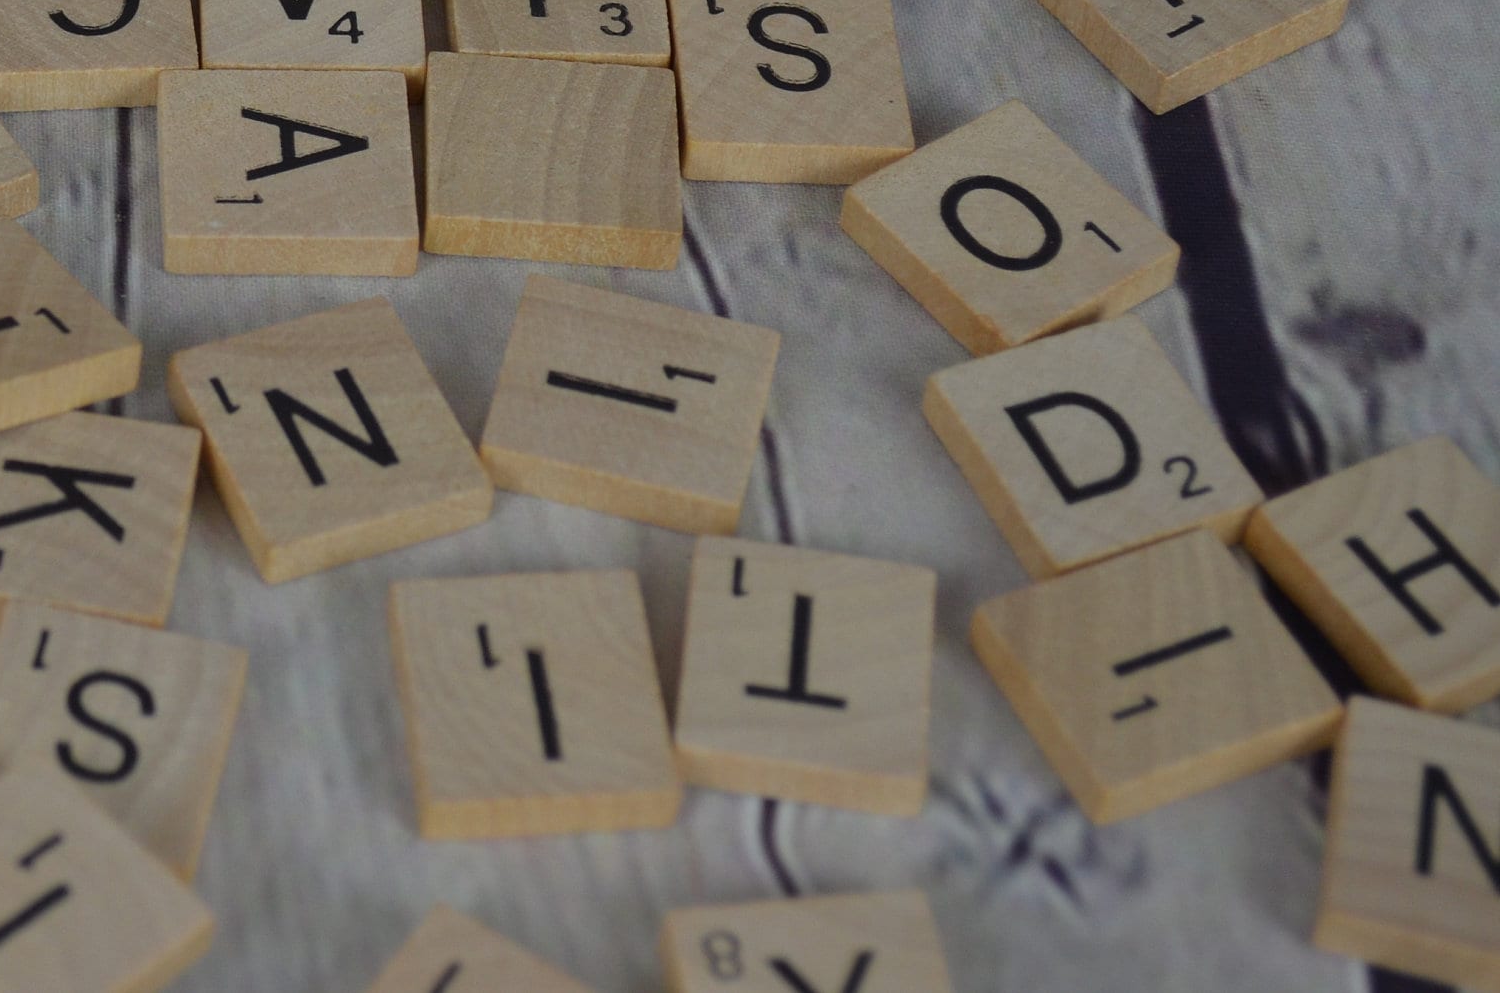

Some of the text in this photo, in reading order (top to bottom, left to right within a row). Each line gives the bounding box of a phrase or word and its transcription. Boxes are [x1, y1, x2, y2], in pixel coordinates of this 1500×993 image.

[746, 5, 831, 92] S
[241, 107, 369, 181] A
[940, 175, 1063, 271] O
[263, 368, 399, 487] N
[1004, 392, 1142, 505] D
[1346, 509, 1500, 635] H
[745, 594, 846, 709] T
[56, 670, 155, 785] S
